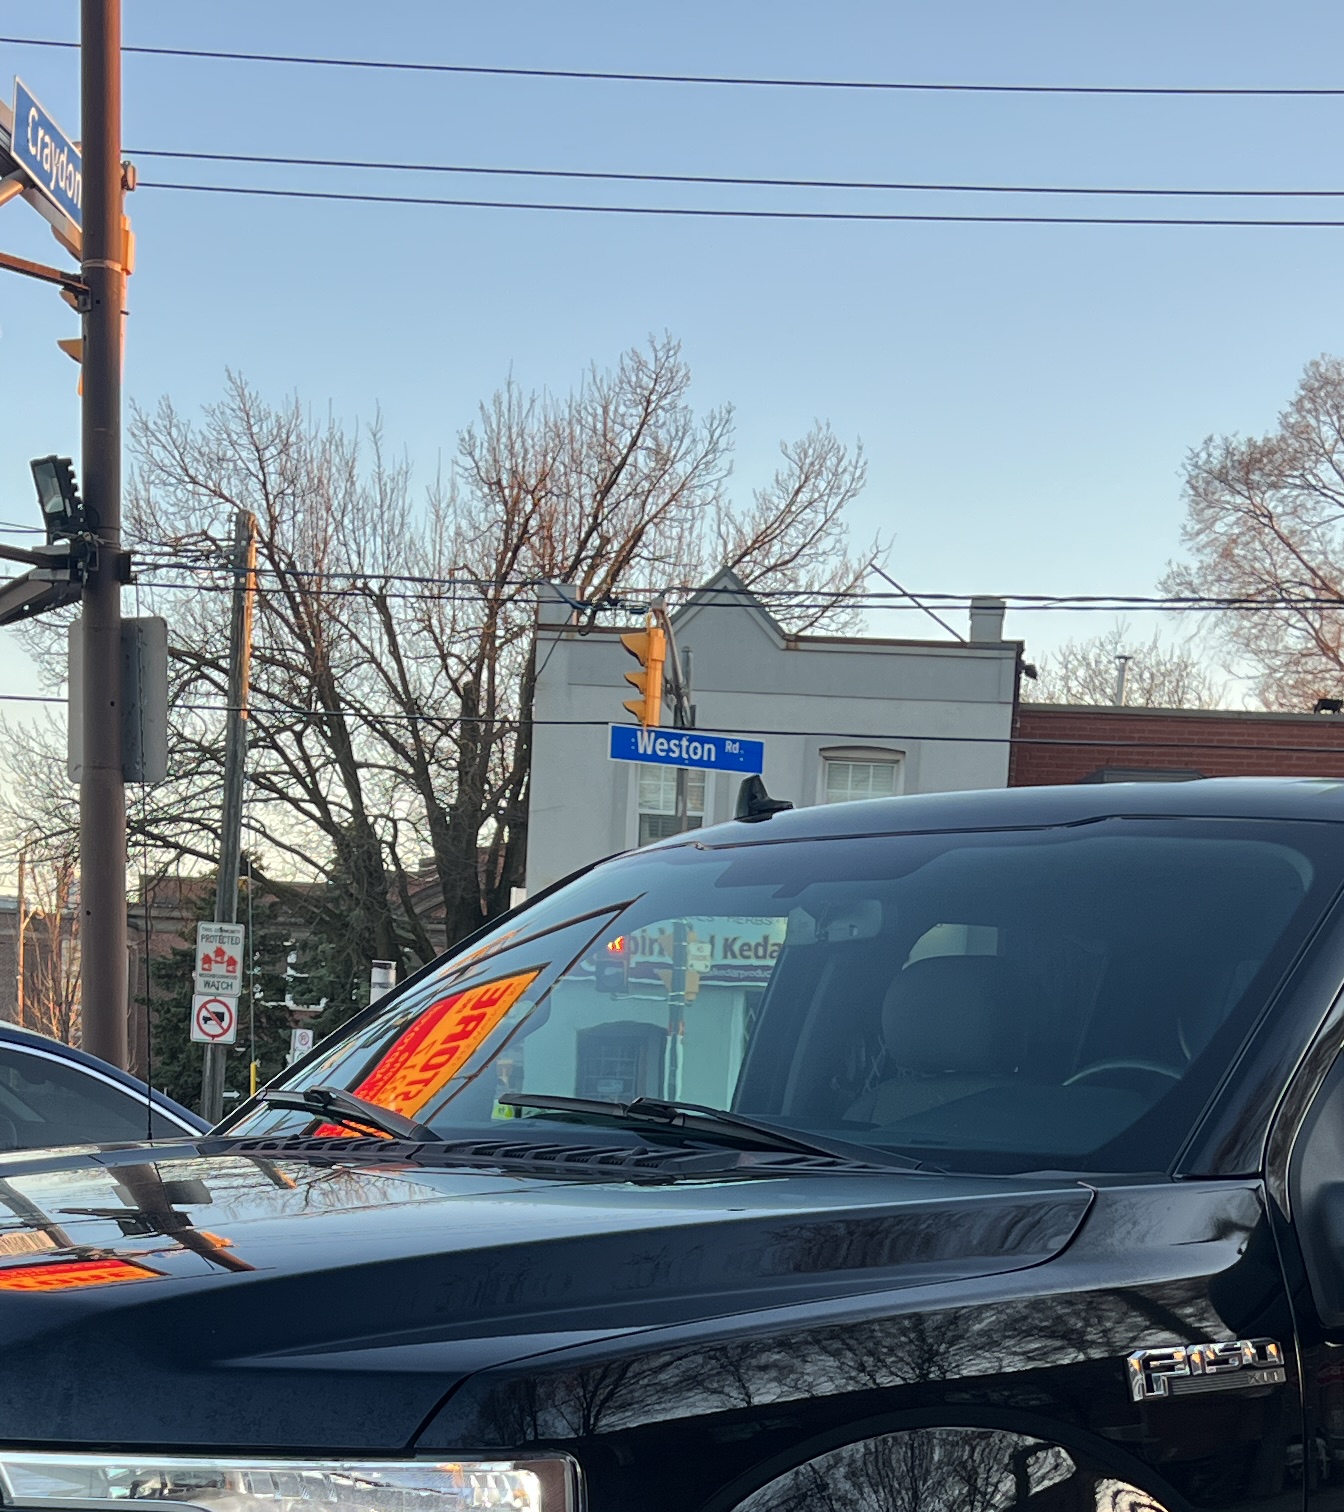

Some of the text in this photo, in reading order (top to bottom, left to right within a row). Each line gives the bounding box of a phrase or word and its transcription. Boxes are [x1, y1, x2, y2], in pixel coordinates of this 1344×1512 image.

[27, 107, 82, 209] Craydon
[636, 730, 740, 761] Weston Rd
[201, 934, 240, 946] PROTECTED
[203, 980, 233, 990] WATCH
